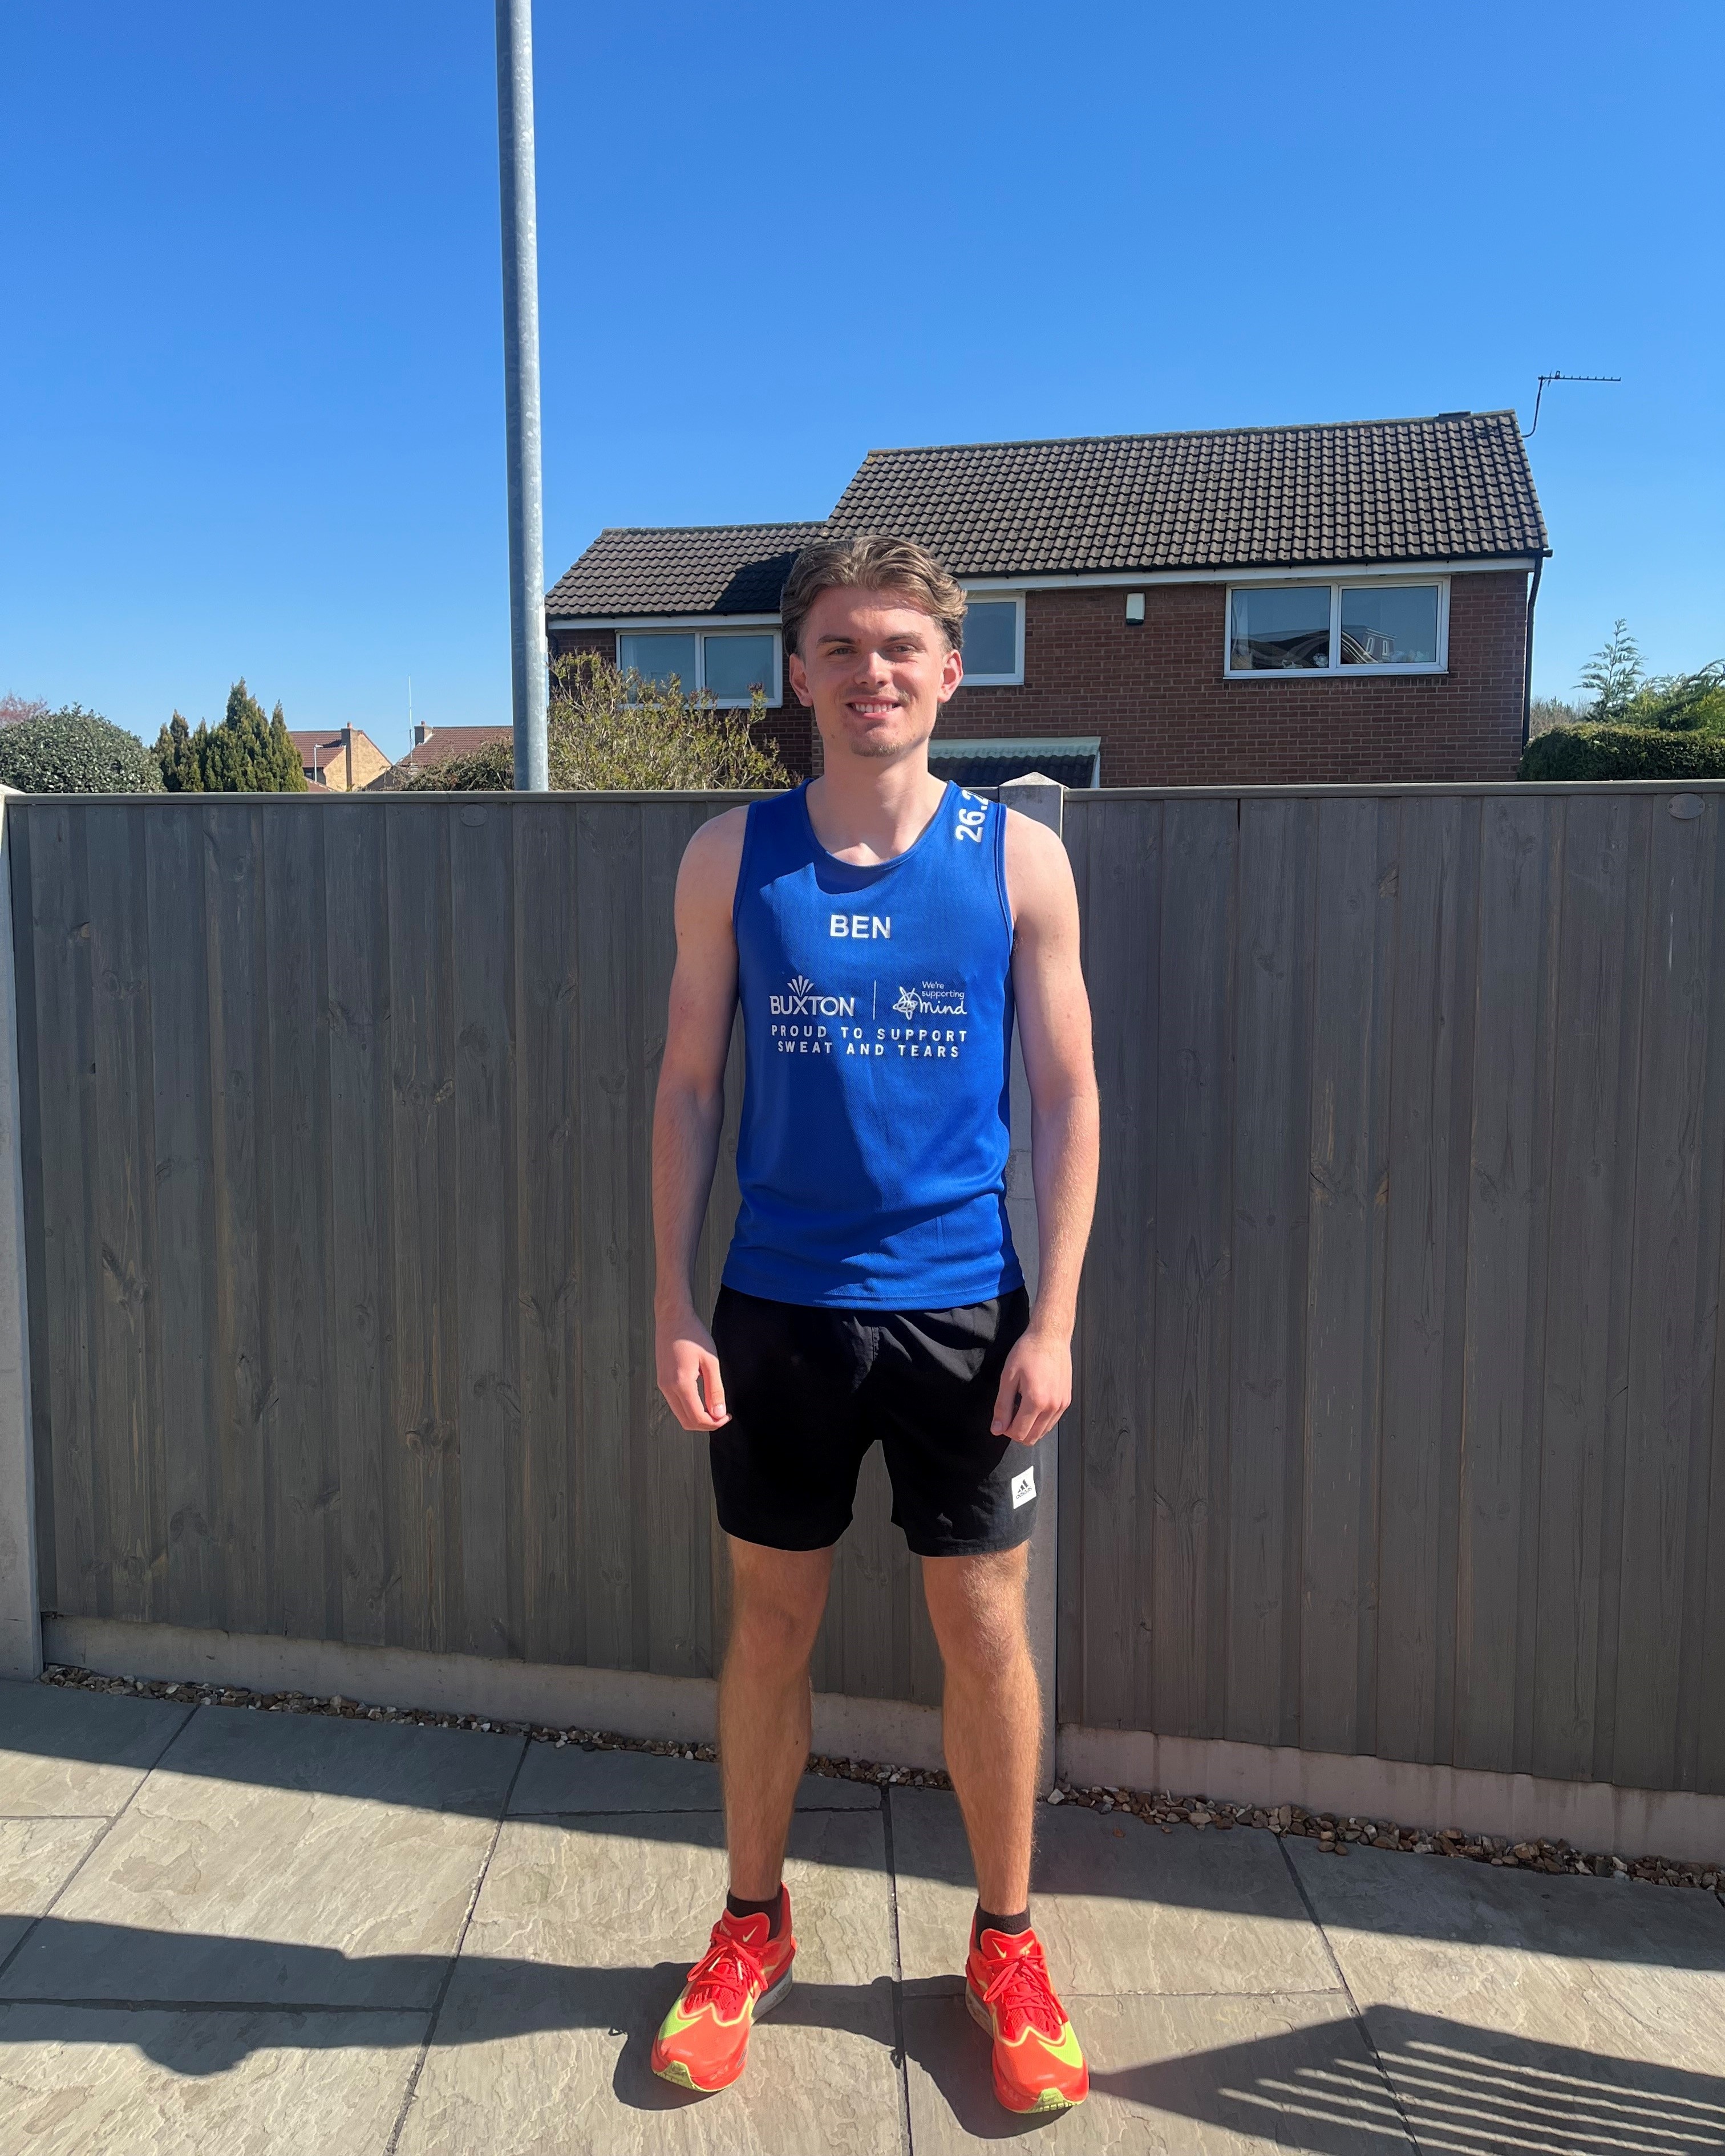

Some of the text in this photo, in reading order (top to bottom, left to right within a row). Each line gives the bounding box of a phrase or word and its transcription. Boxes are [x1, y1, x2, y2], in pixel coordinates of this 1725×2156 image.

[830, 914, 892, 938] BEN
[922, 980, 945, 989] We're
[921, 990, 965, 1000] supporting
[769, 995, 855, 1017] BUXTON
[920, 1000, 967, 1015] mind
[771, 1024, 967, 1042] PROUD TO SUPPORT
[778, 1040, 959, 1057] SWEAT AND TEARS
